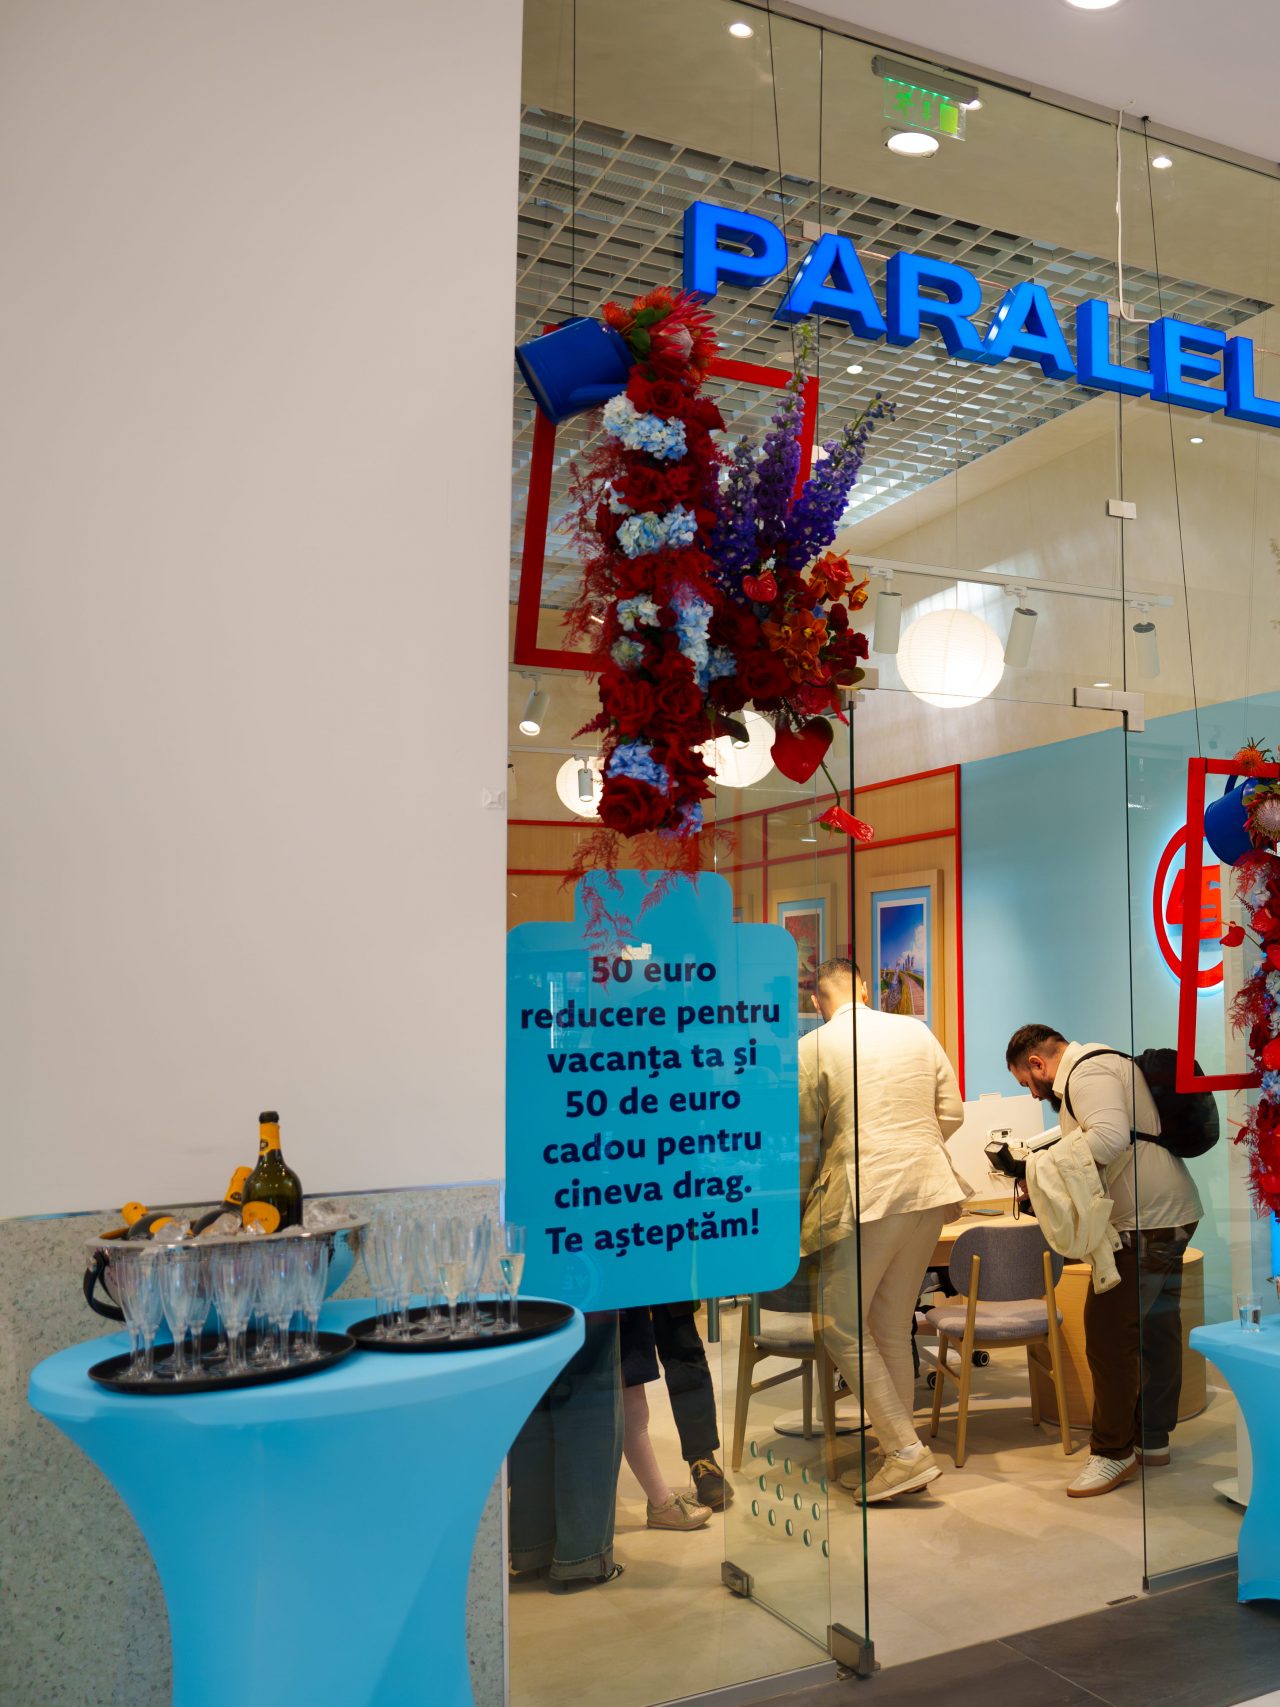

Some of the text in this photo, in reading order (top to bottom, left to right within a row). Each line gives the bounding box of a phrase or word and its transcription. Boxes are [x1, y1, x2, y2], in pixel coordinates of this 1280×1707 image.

[592, 956, 717, 984] 50 euro
[520, 1000, 780, 1033] reducere pentru
[547, 1039, 757, 1079] vacanța ta și
[565, 1087, 741, 1119] 50 de euro
[542, 1129, 762, 1166] cadou pentru
[554, 1170, 752, 1209] cineva drag.
[545, 1208, 760, 1257] Te așteptăm!
